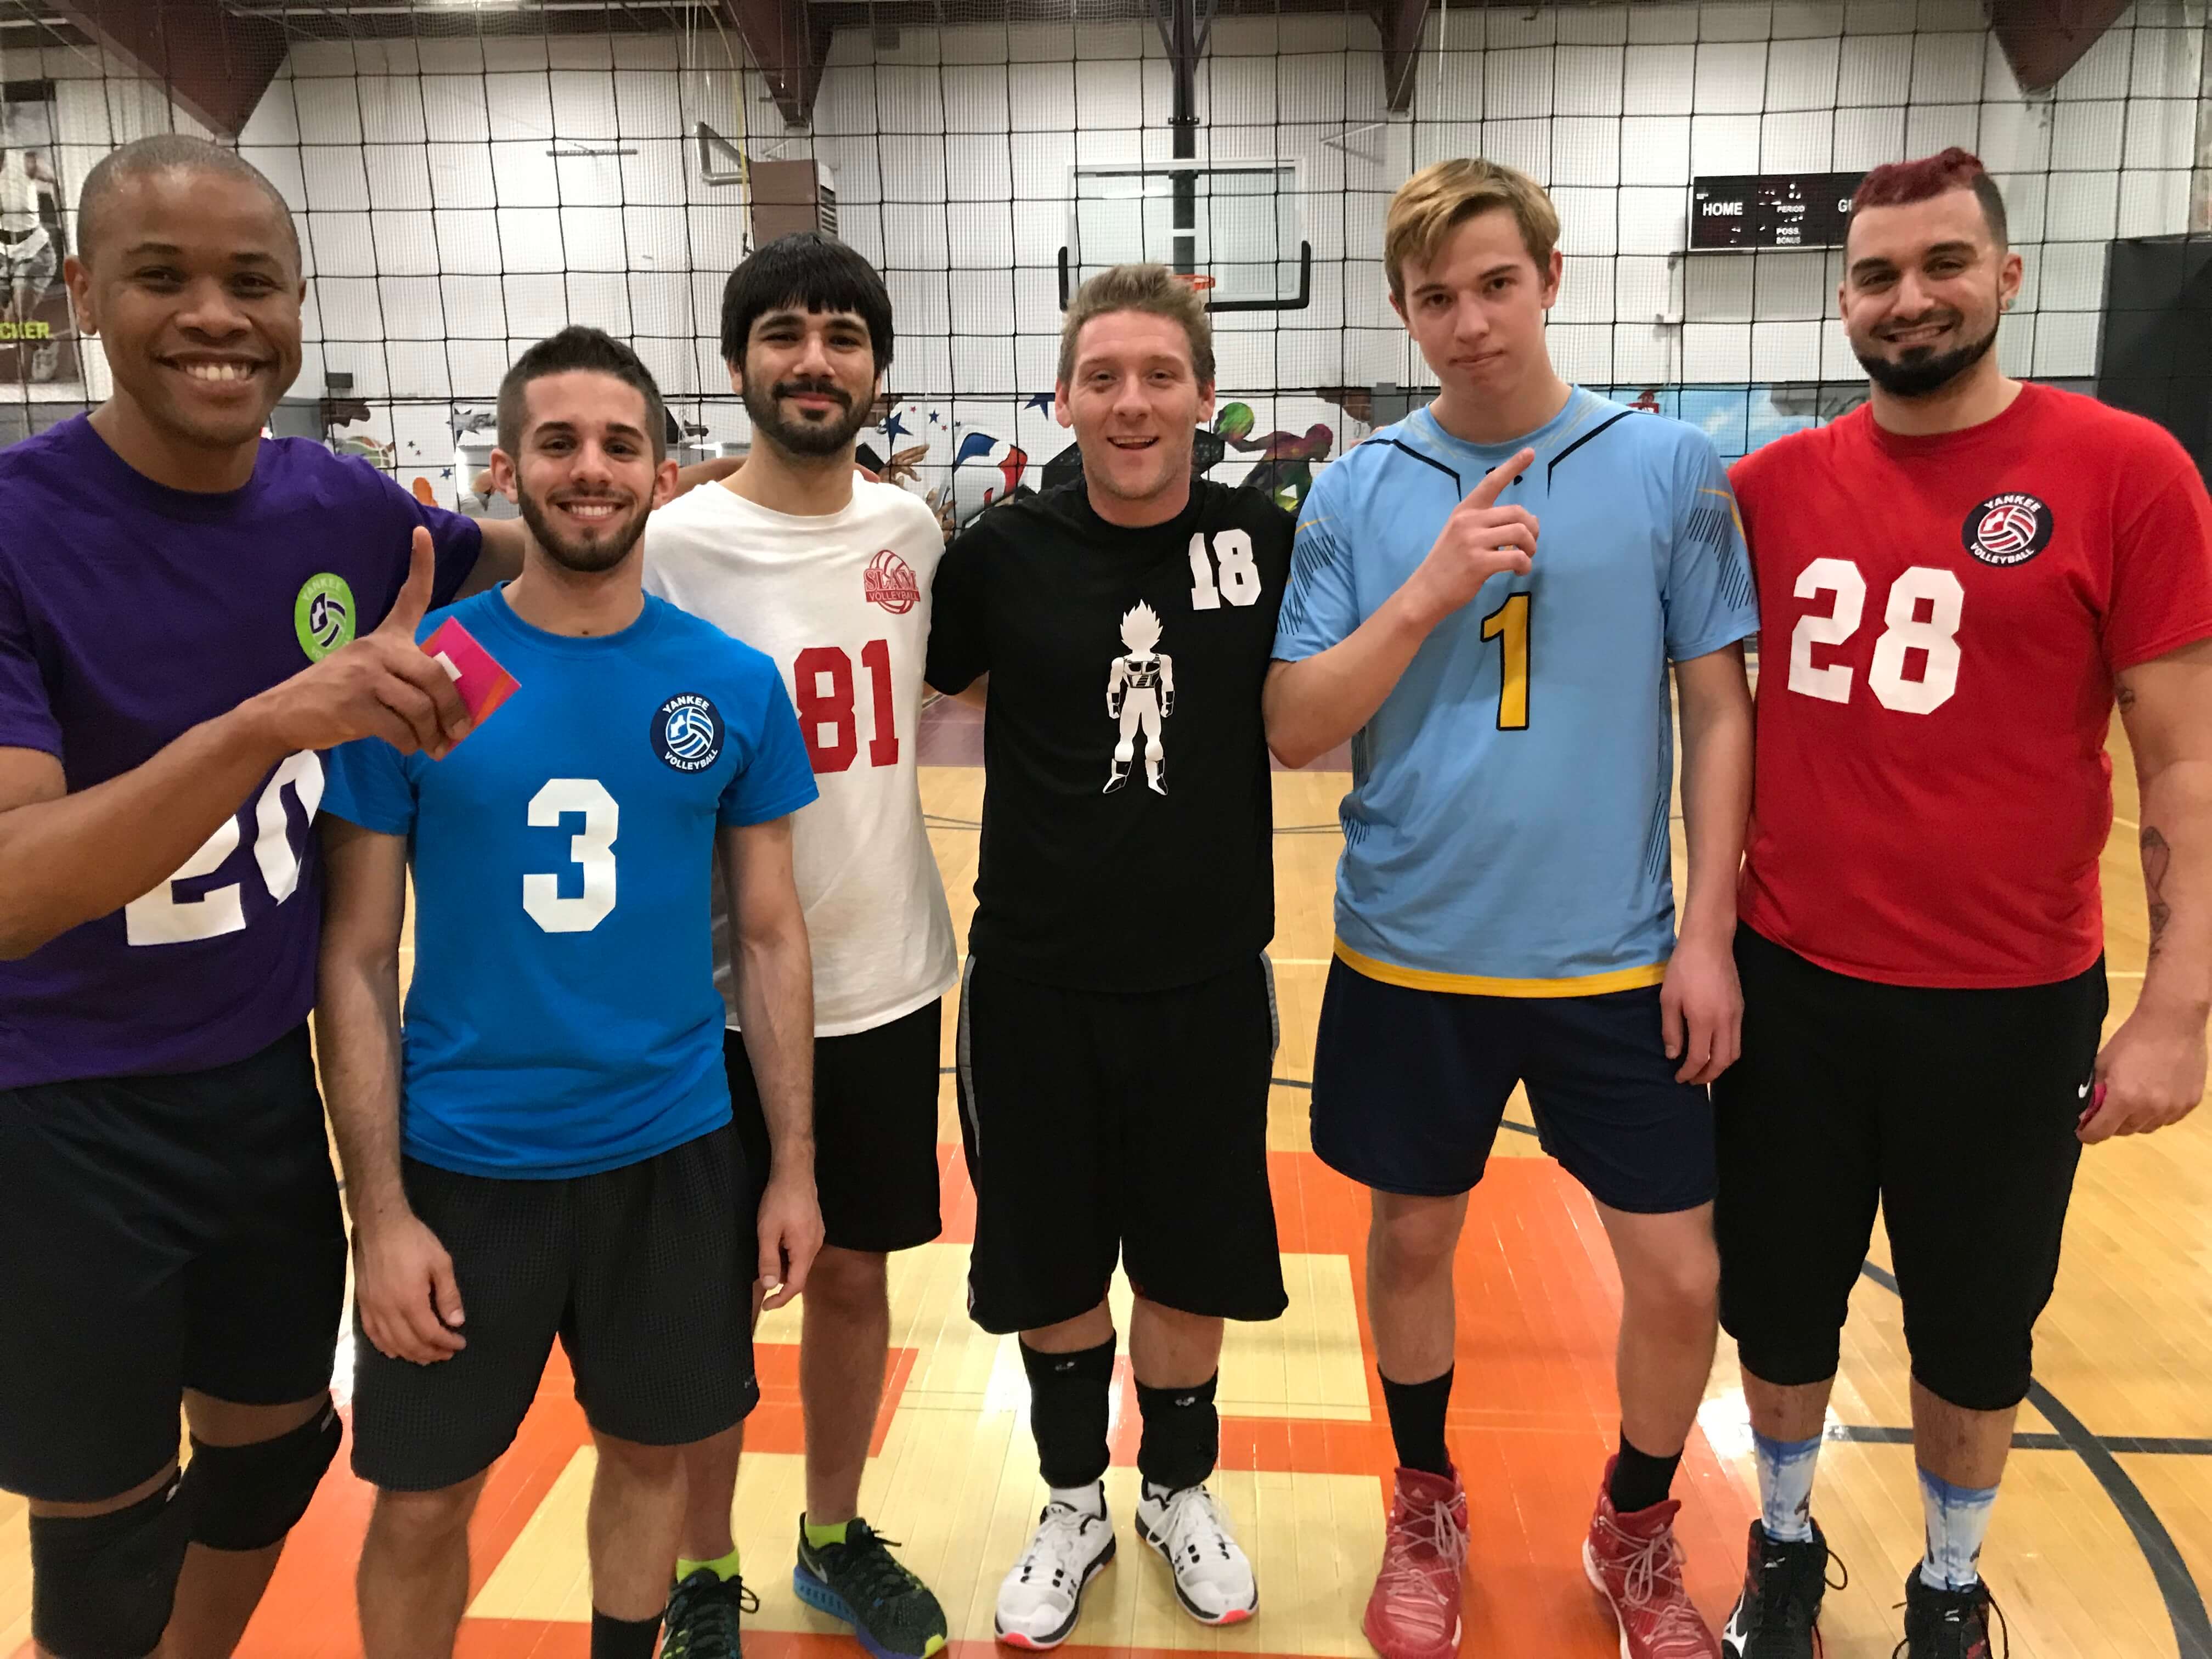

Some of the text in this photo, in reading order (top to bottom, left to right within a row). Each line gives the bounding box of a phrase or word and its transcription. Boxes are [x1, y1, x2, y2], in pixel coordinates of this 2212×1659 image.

[1702, 202, 1743, 216] HOME
[1983, 495, 2042, 512] YANKEE
[1970, 542, 2035, 564] VOLLEYBALL
[864, 569, 918, 591] SLAM
[1188, 528, 1262, 611] 18
[302, 578, 343, 601] YANKEE
[869, 592, 918, 601] VOLLEYBALL
[1787, 557, 1965, 715] 28
[1480, 591, 1532, 731] 1
[662, 696, 709, 714] YANKEE
[794, 639, 899, 774] 81
[664, 749, 718, 770] VOLLEYBALL
[523, 778, 619, 933] 3
